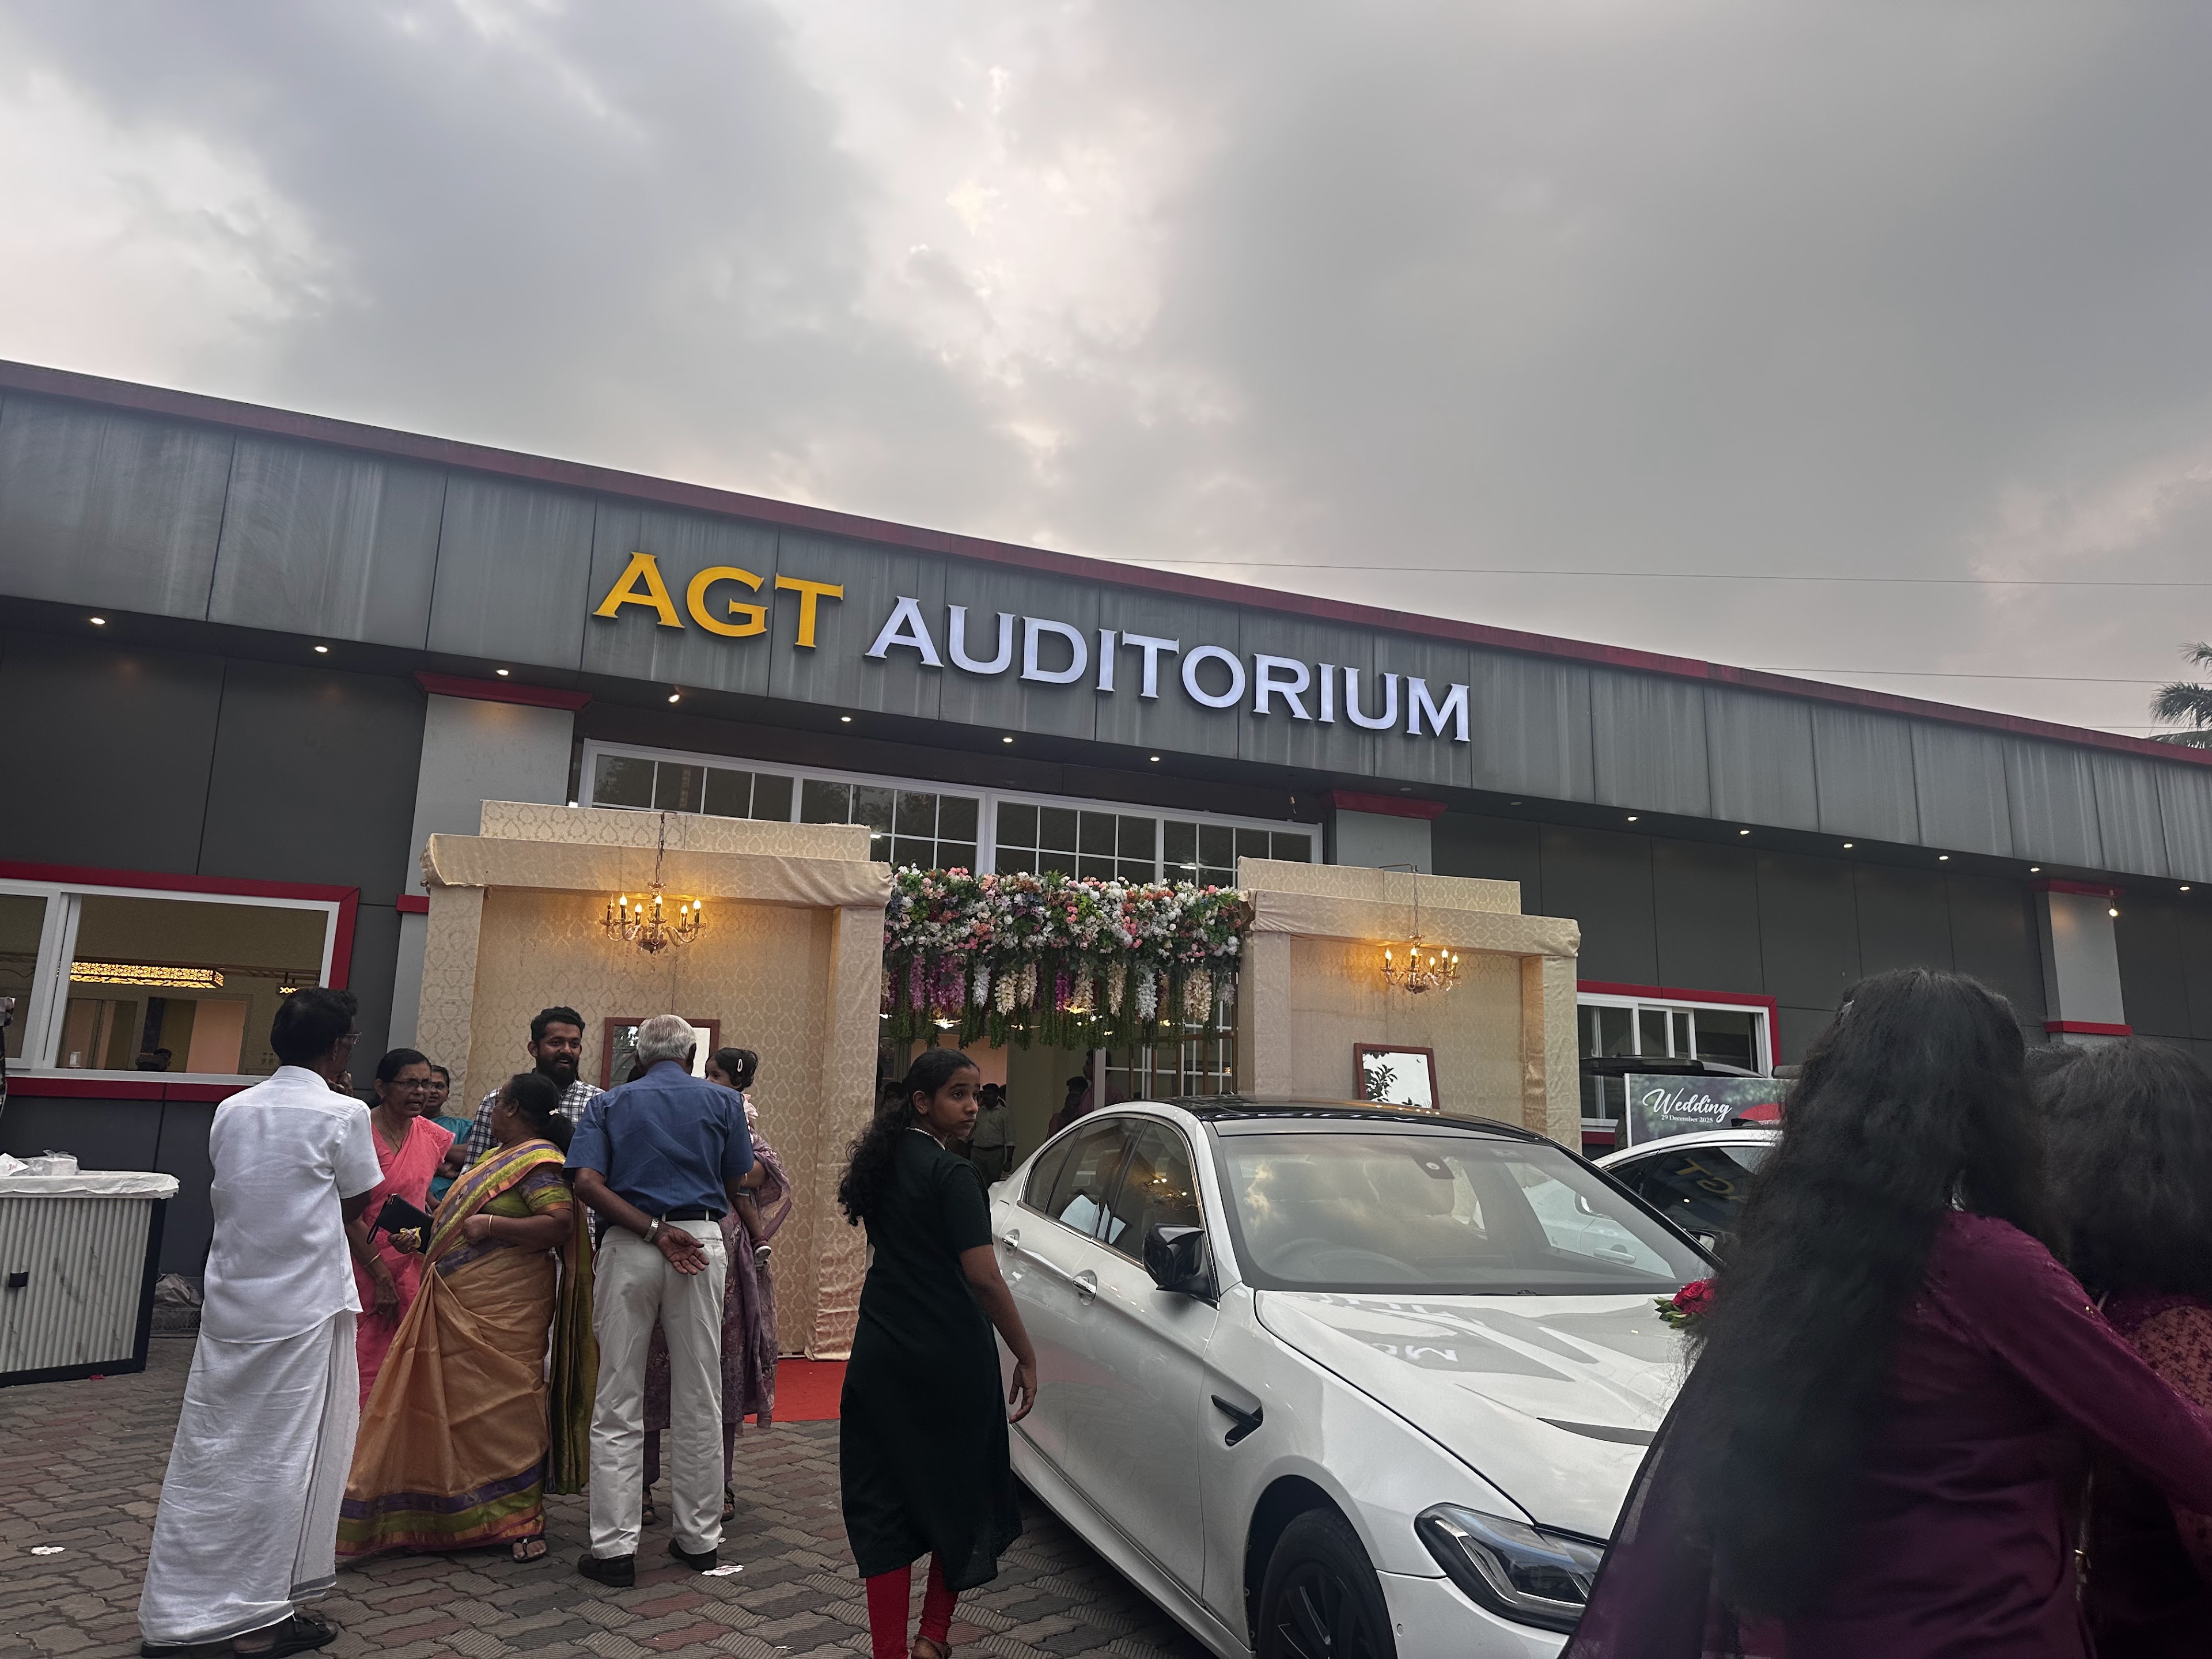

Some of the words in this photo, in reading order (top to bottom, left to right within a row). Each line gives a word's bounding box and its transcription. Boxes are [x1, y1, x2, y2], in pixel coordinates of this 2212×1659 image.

[593, 551, 844, 649] AGT
[865, 596, 1471, 743] AUDITORIUM
[1642, 1088, 1733, 1123] Wedding
